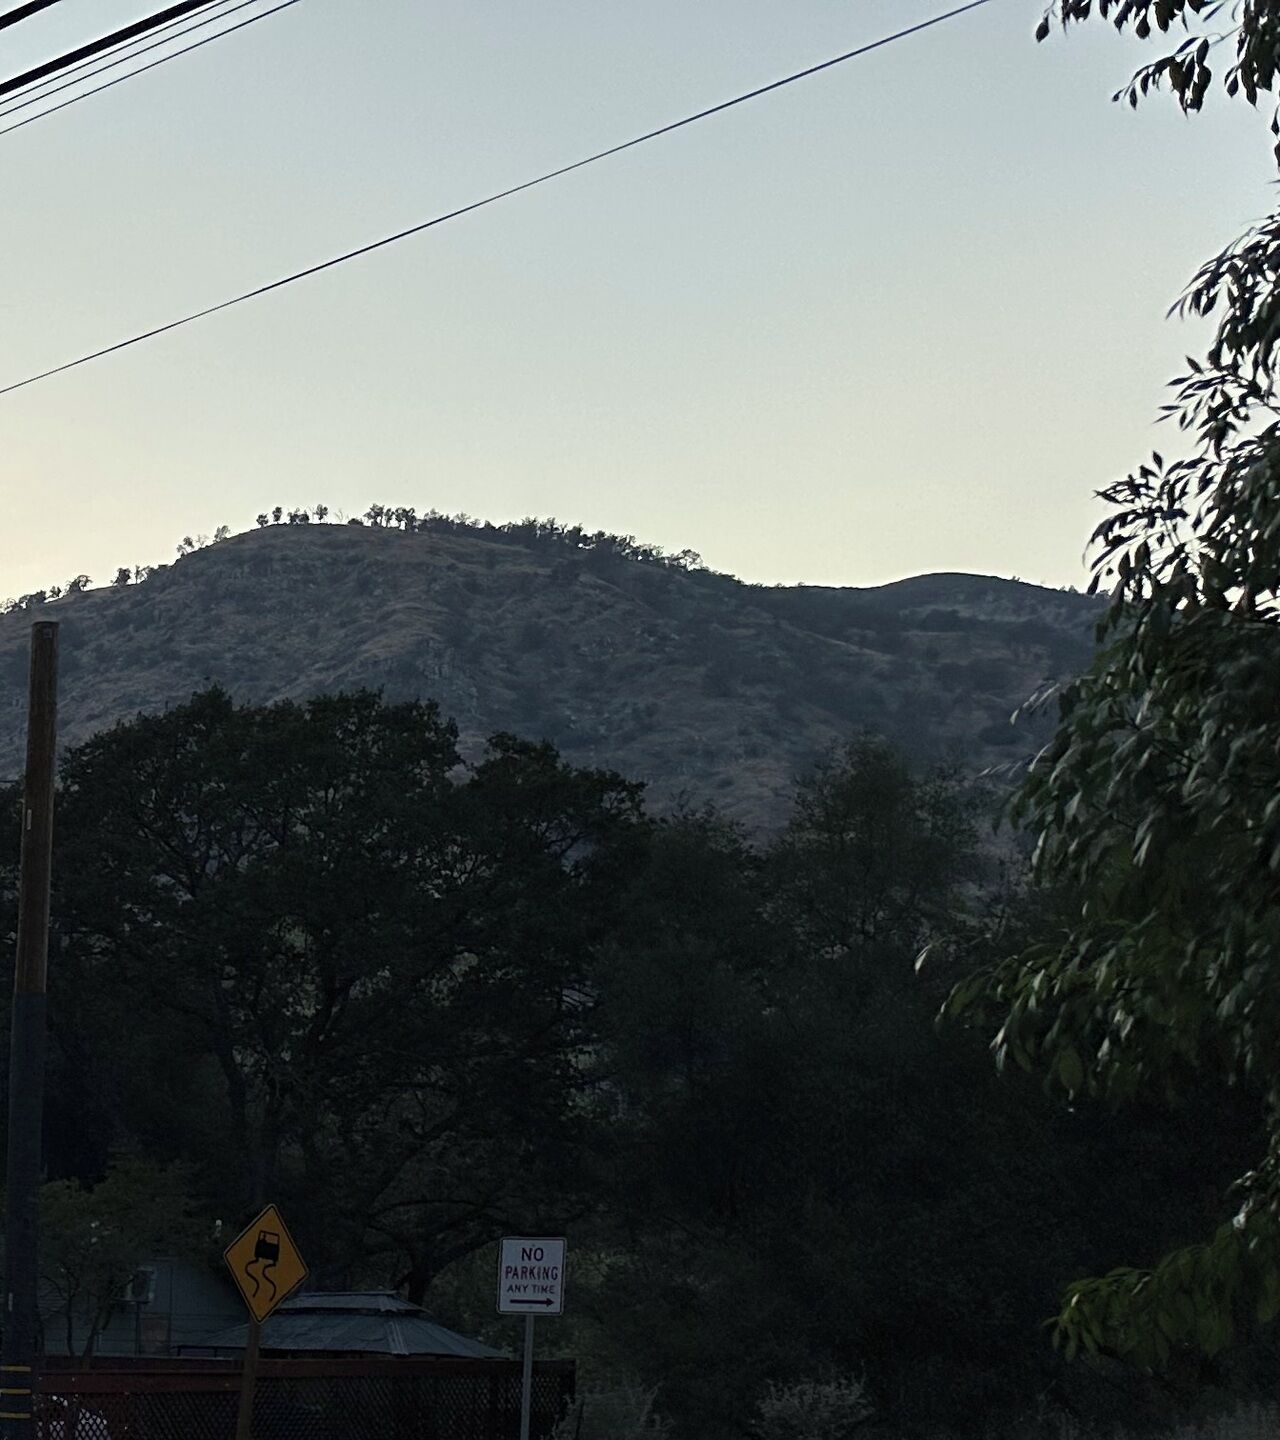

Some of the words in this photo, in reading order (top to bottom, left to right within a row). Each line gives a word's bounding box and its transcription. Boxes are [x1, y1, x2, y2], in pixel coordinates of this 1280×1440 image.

[521, 1247, 544, 1262] NO
[505, 1265, 558, 1281] PARKING
[506, 1284, 529, 1294] ANY
[532, 1284, 555, 1295] TIME
